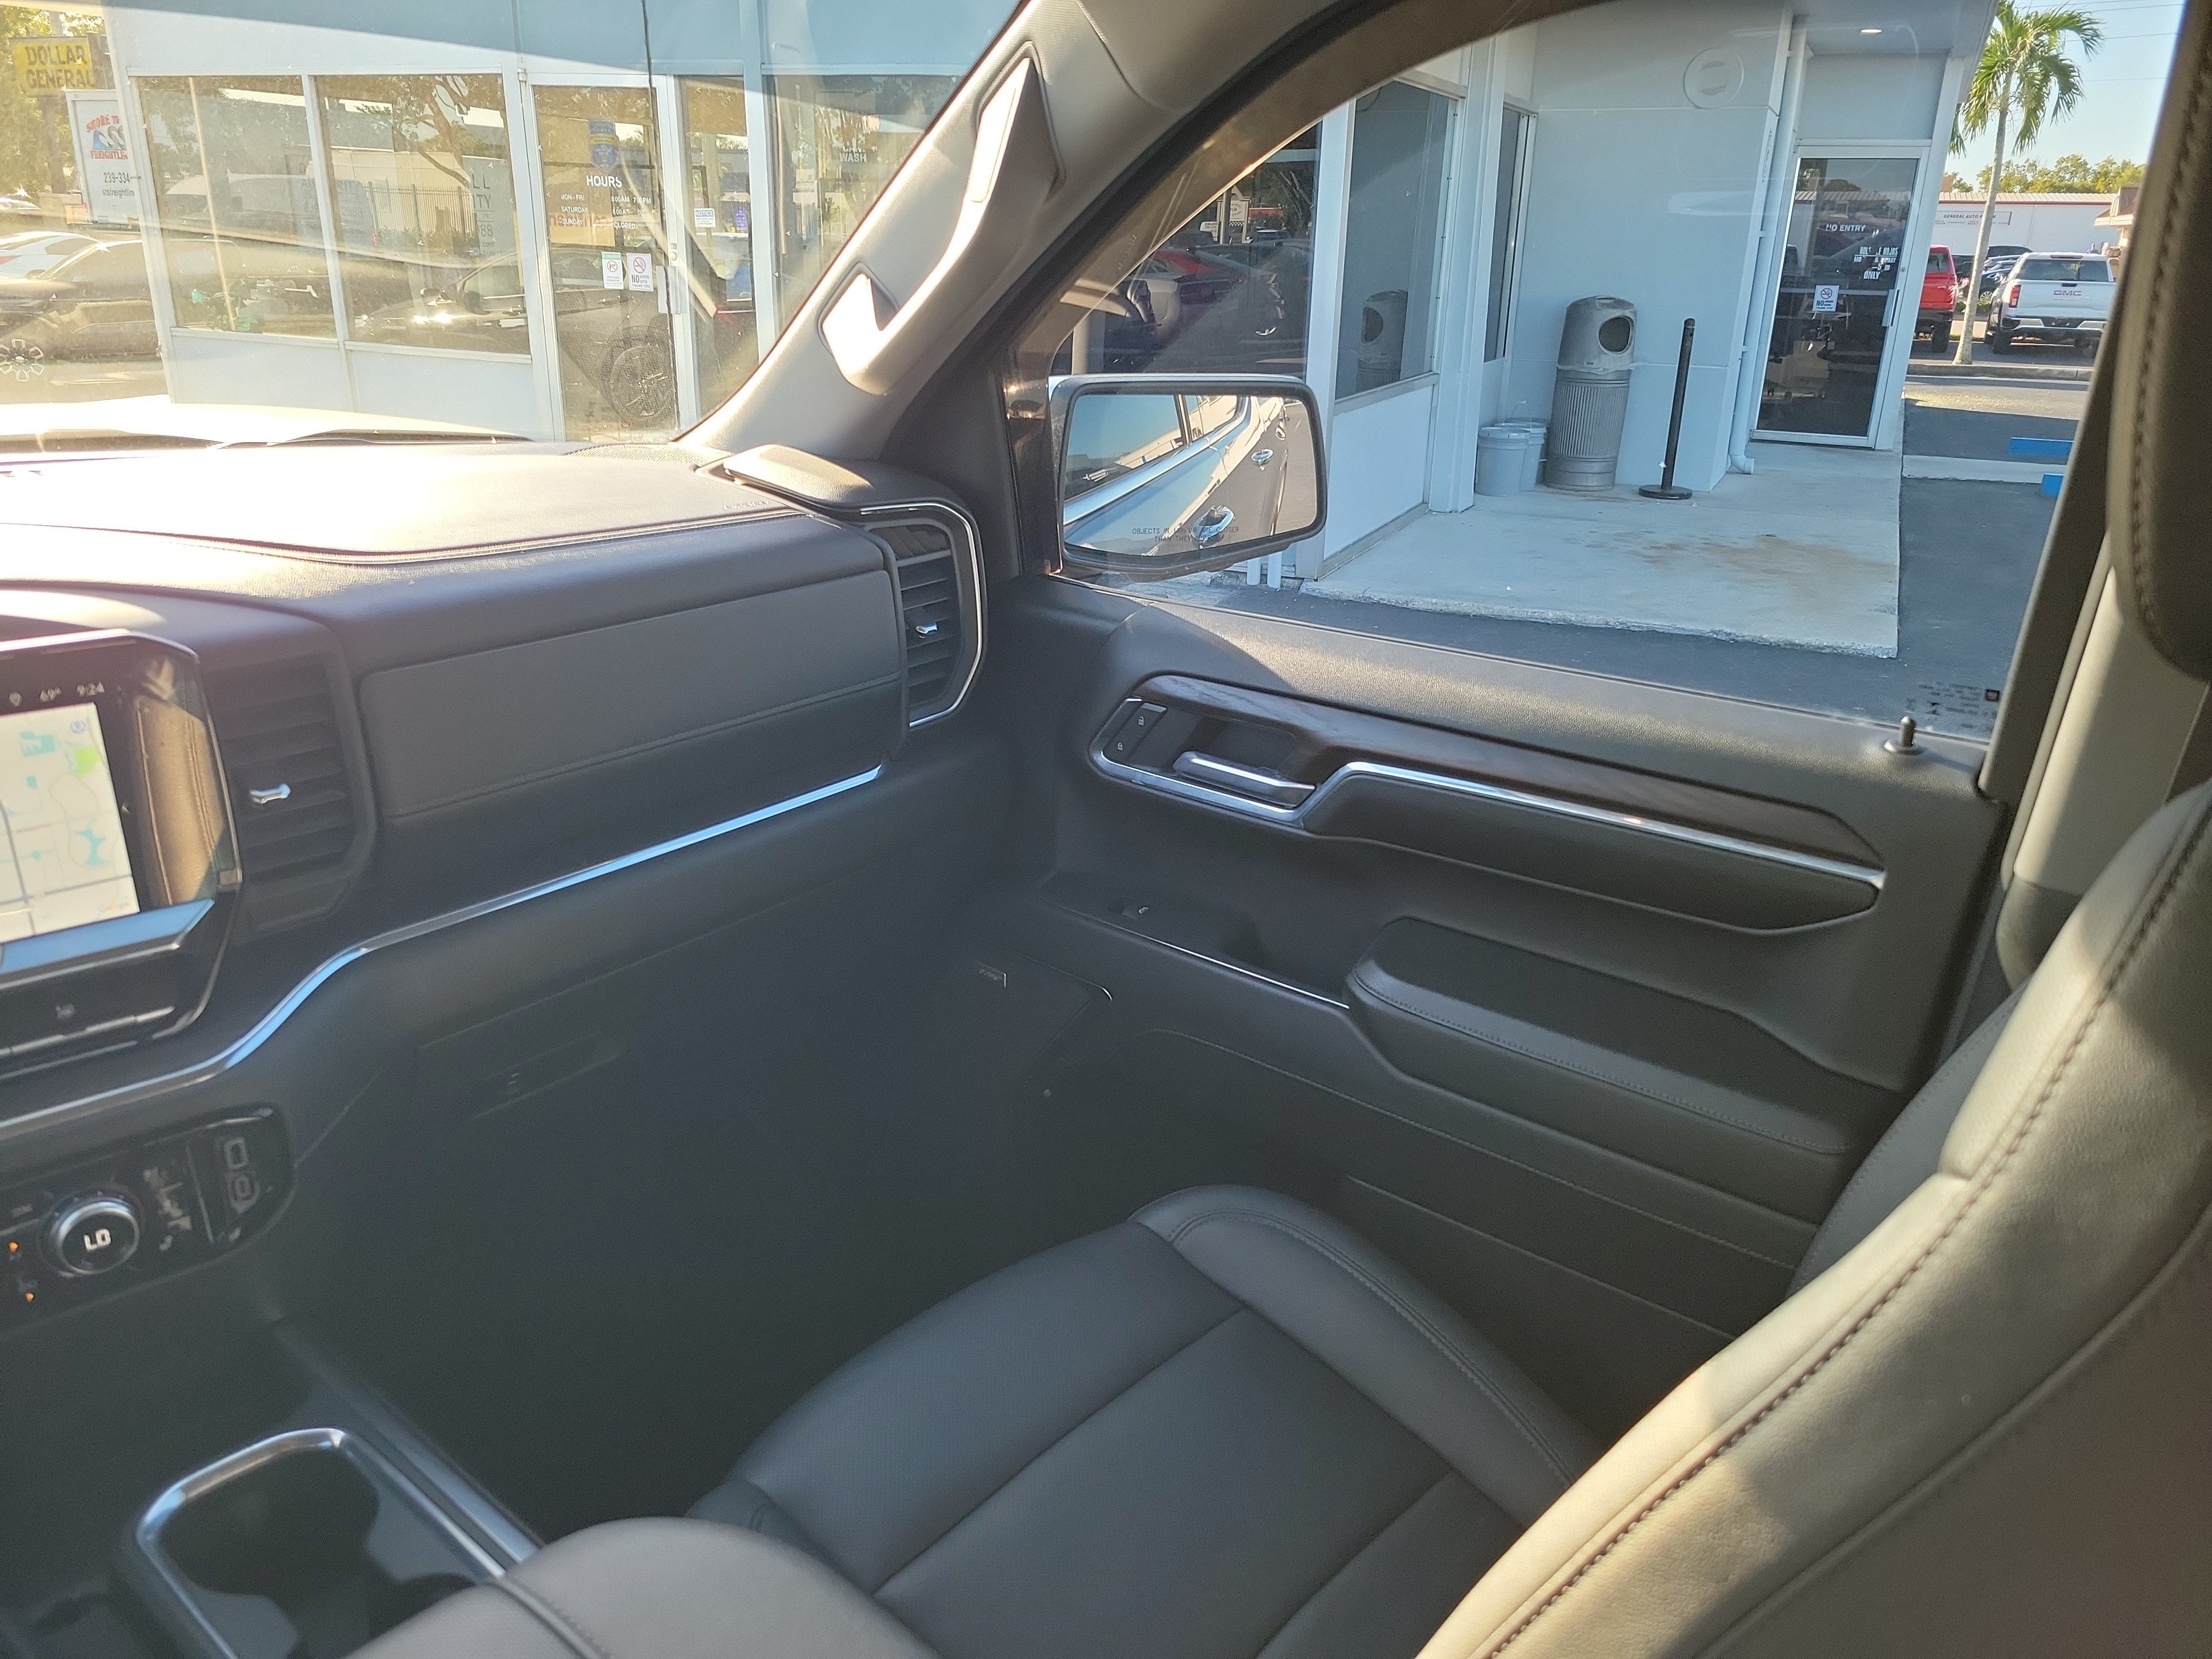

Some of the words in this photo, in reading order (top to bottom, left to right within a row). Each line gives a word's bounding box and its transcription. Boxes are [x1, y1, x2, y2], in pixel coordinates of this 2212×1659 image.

[26, 44, 88, 65] DOLLAR
[27, 69, 95, 88] GENERAL
[87, 114, 110, 133] SHORE
[111, 115, 120, 125] TO
[839, 153, 867, 162] WASH
[586, 174, 623, 188] HOURS
[1839, 224, 1866, 232] ENTRY
[631, 274, 640, 283] NO
[1863, 271, 1881, 280] ONLY
